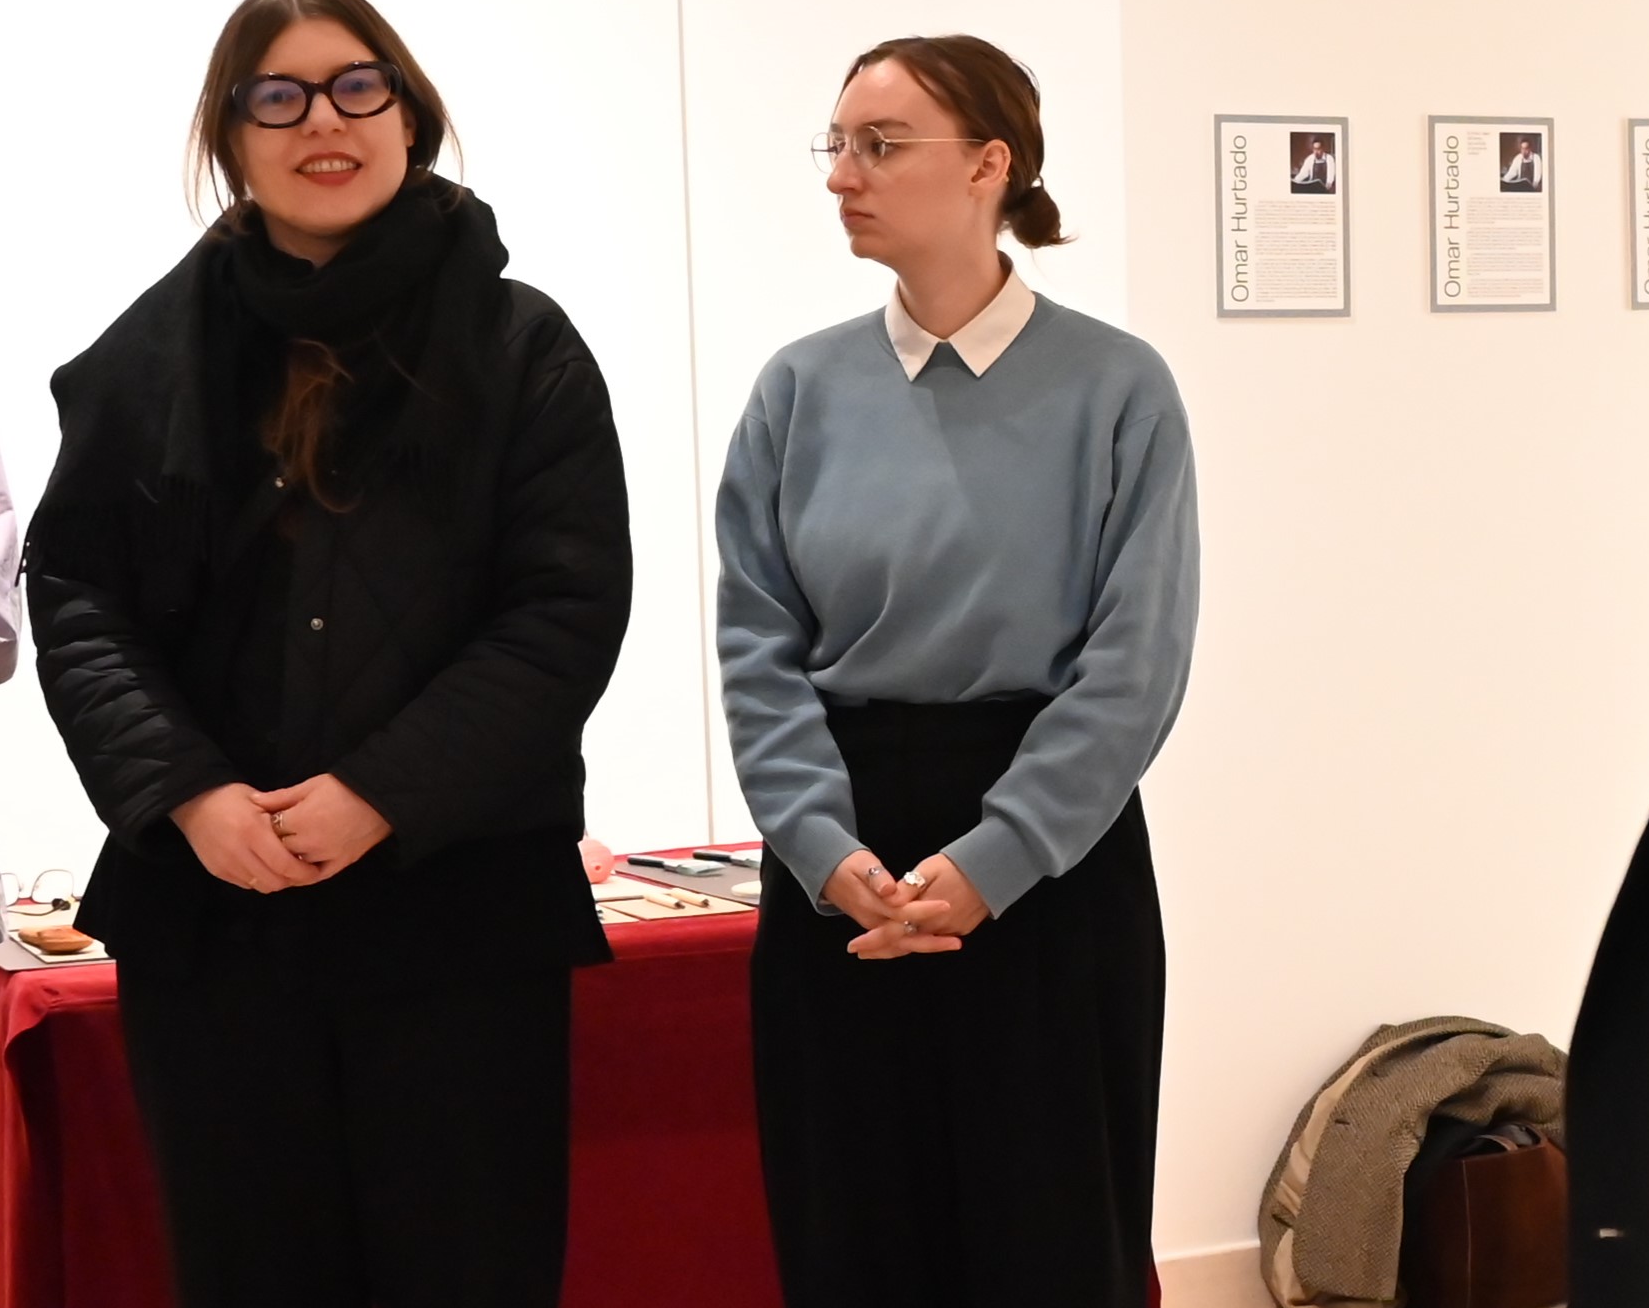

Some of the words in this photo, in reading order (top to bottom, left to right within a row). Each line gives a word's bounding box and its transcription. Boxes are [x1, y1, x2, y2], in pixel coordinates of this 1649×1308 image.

[1230, 135, 1248, 232] Hurtado
[1443, 135, 1459, 229] Hurtado
[1231, 240, 1249, 302] Omar
[1444, 238, 1461, 298] Omar
